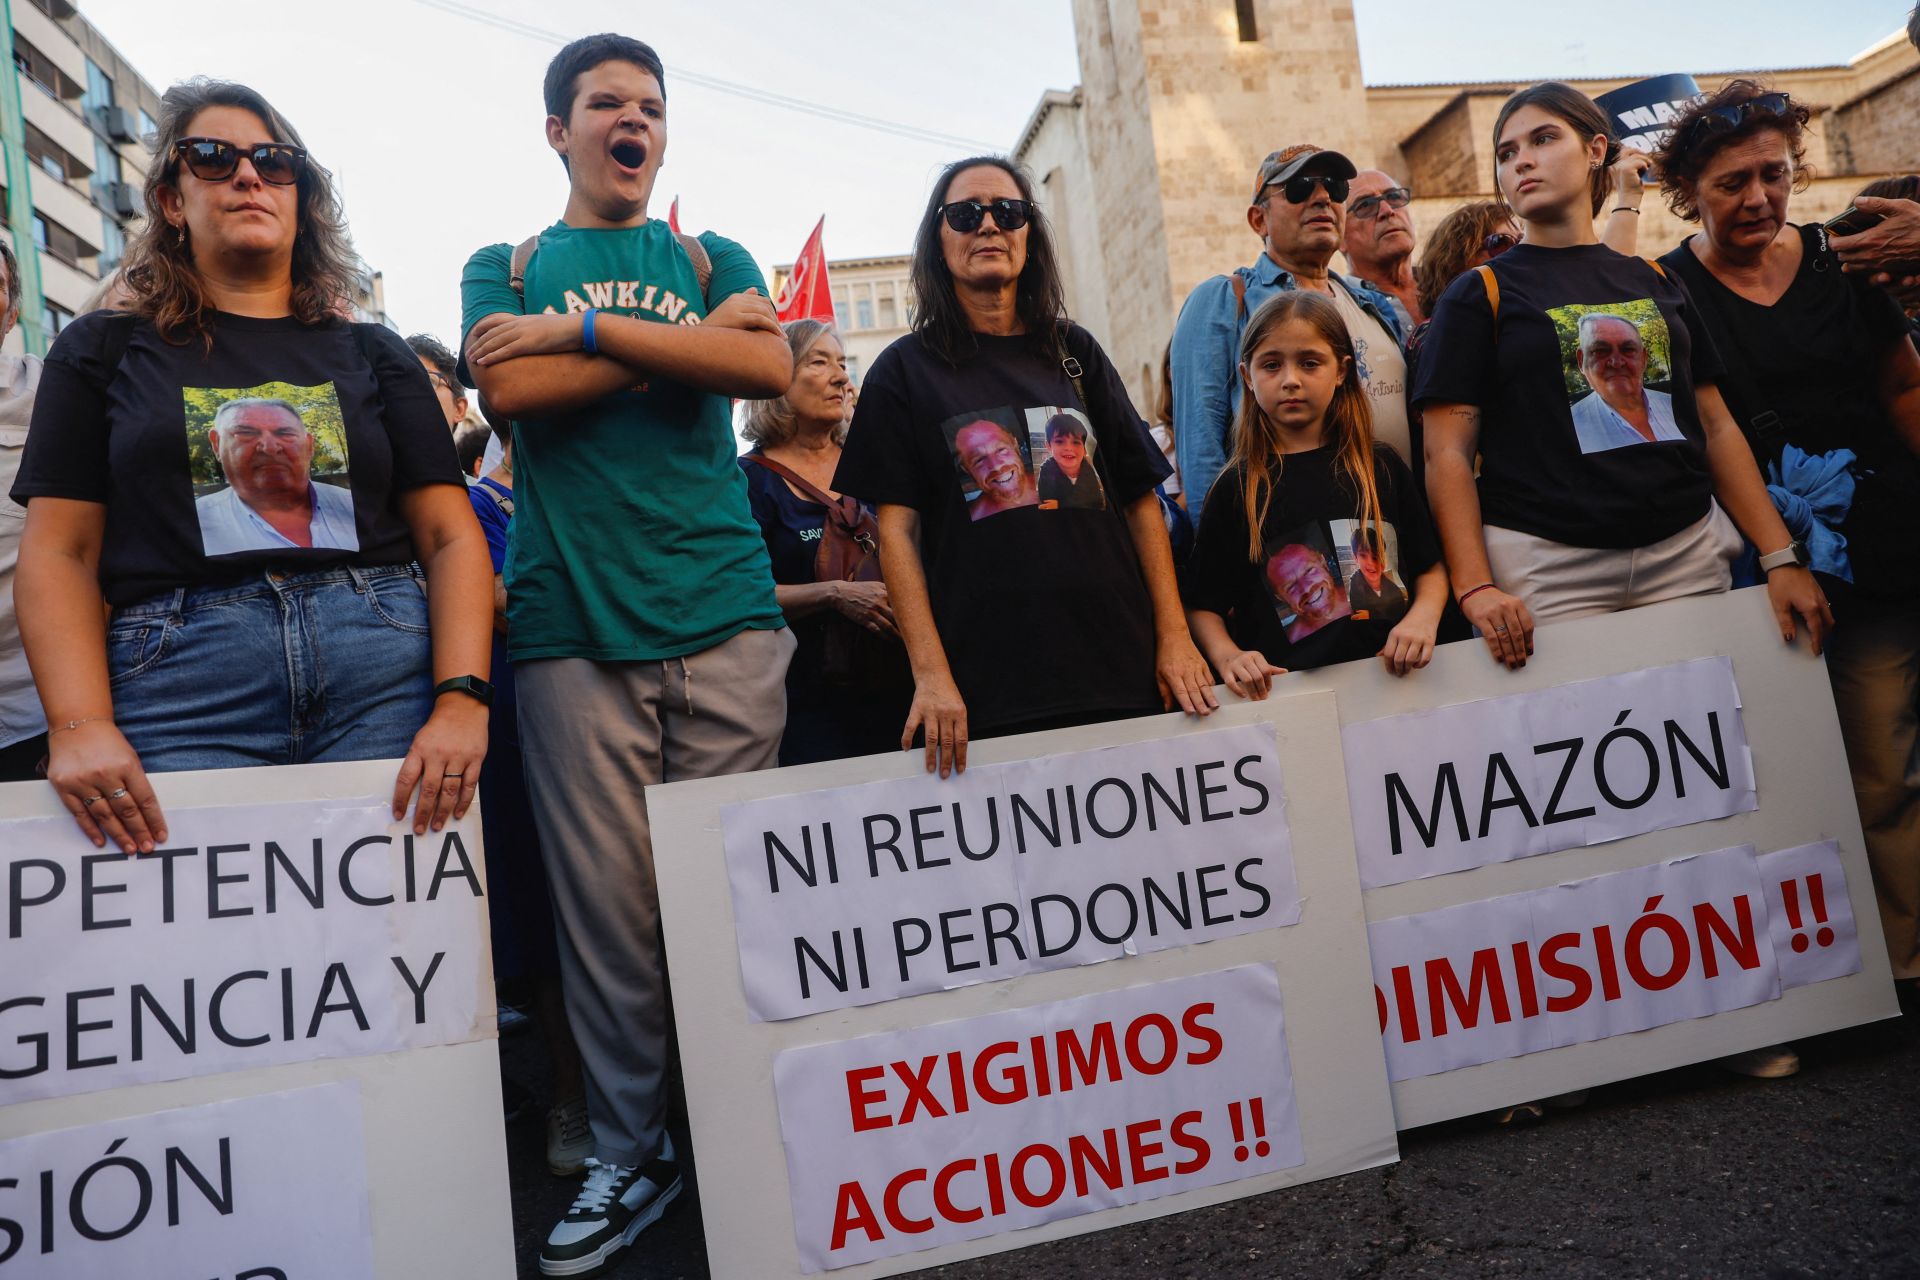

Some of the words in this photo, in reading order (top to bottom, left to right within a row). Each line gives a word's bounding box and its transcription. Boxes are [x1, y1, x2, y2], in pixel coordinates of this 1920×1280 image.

[543, 280, 701, 327] AWKINS
[799, 527, 824, 542] SAV
[763, 821, 839, 894] NI
[862, 754, 1270, 878] REUNIONES
[1384, 708, 1731, 856] MAZÓN
[9, 831, 485, 939] PETENCIA
[793, 927, 870, 1000] NI
[892, 857, 1271, 982] PERDONES
[391, 951, 446, 1024] Y
[1374, 895, 1761, 1043] IMISIÓN
[1780, 873, 1834, 953] !!
[845, 1002, 1223, 1133] EXIGIMOS
[829, 1110, 1212, 1251] ACCIONES
[1227, 1097, 1271, 1162] !!
